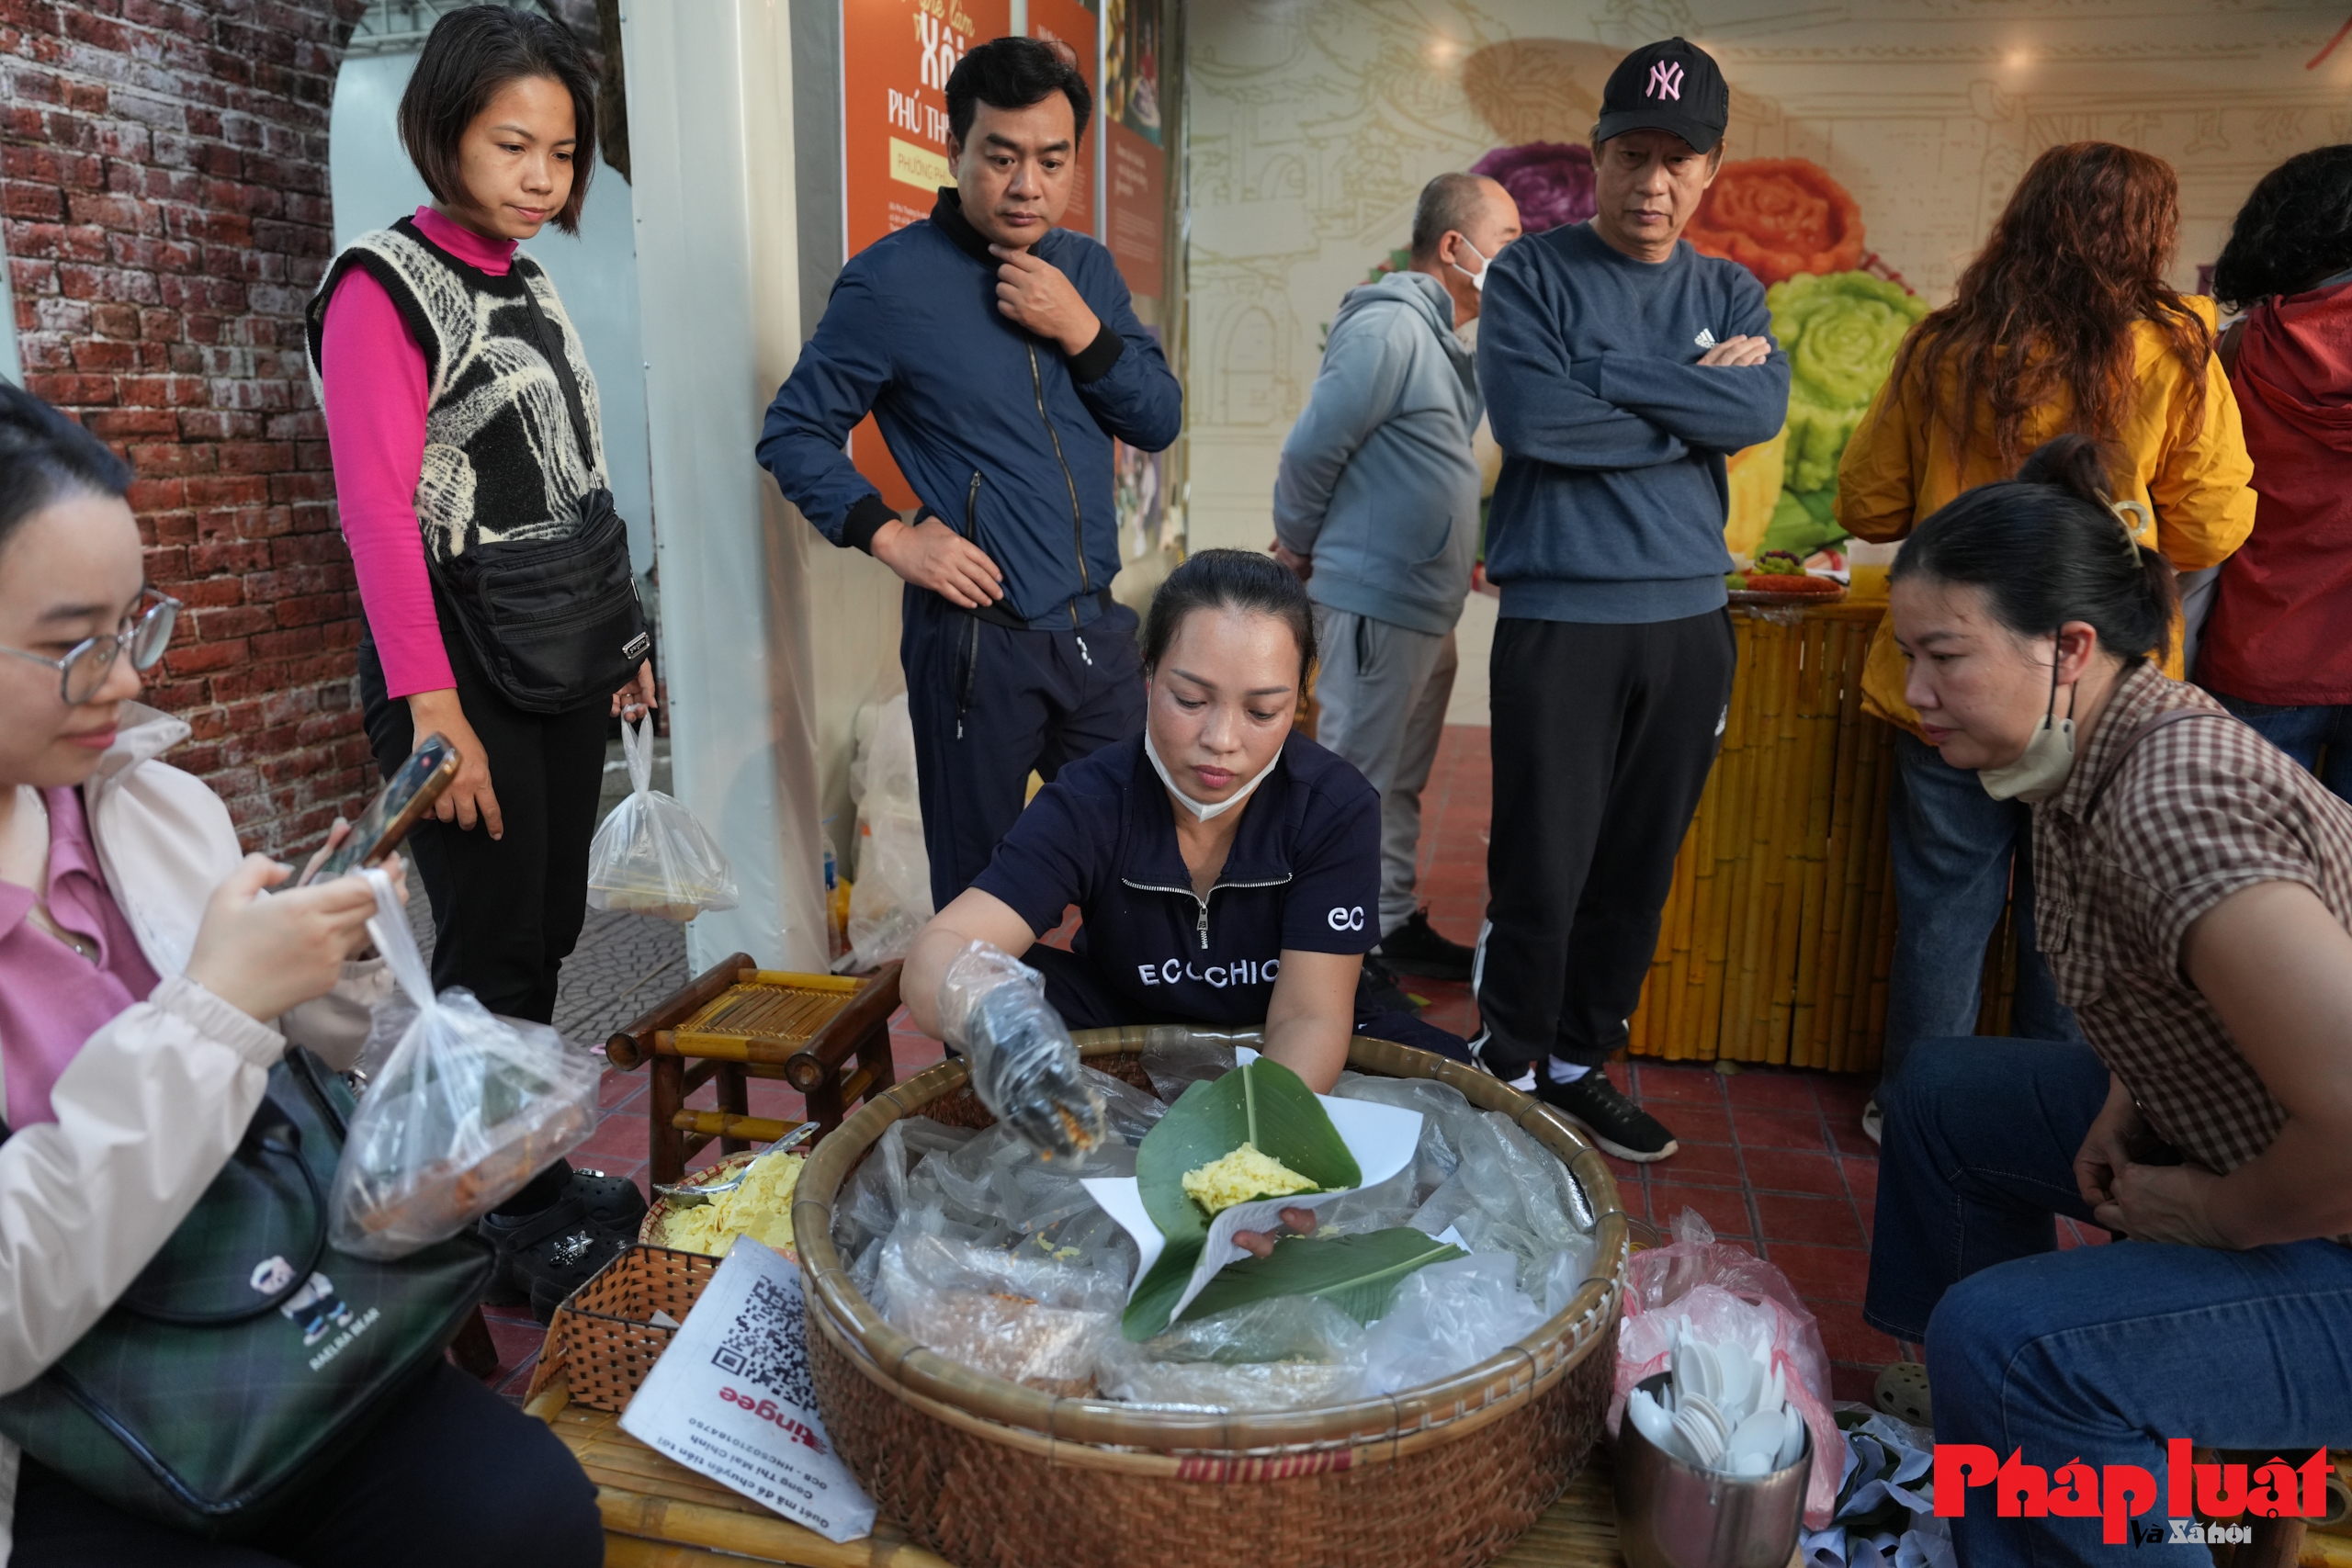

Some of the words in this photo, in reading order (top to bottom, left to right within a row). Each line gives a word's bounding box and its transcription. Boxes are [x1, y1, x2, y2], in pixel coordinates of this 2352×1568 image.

[1645, 60, 1685, 101] NY
[888, 87, 922, 134] PHÚ
[719, 1386, 818, 1450] tingee
[776, 1495, 797, 1510] mã
[798, 1506, 830, 1529] Quét
